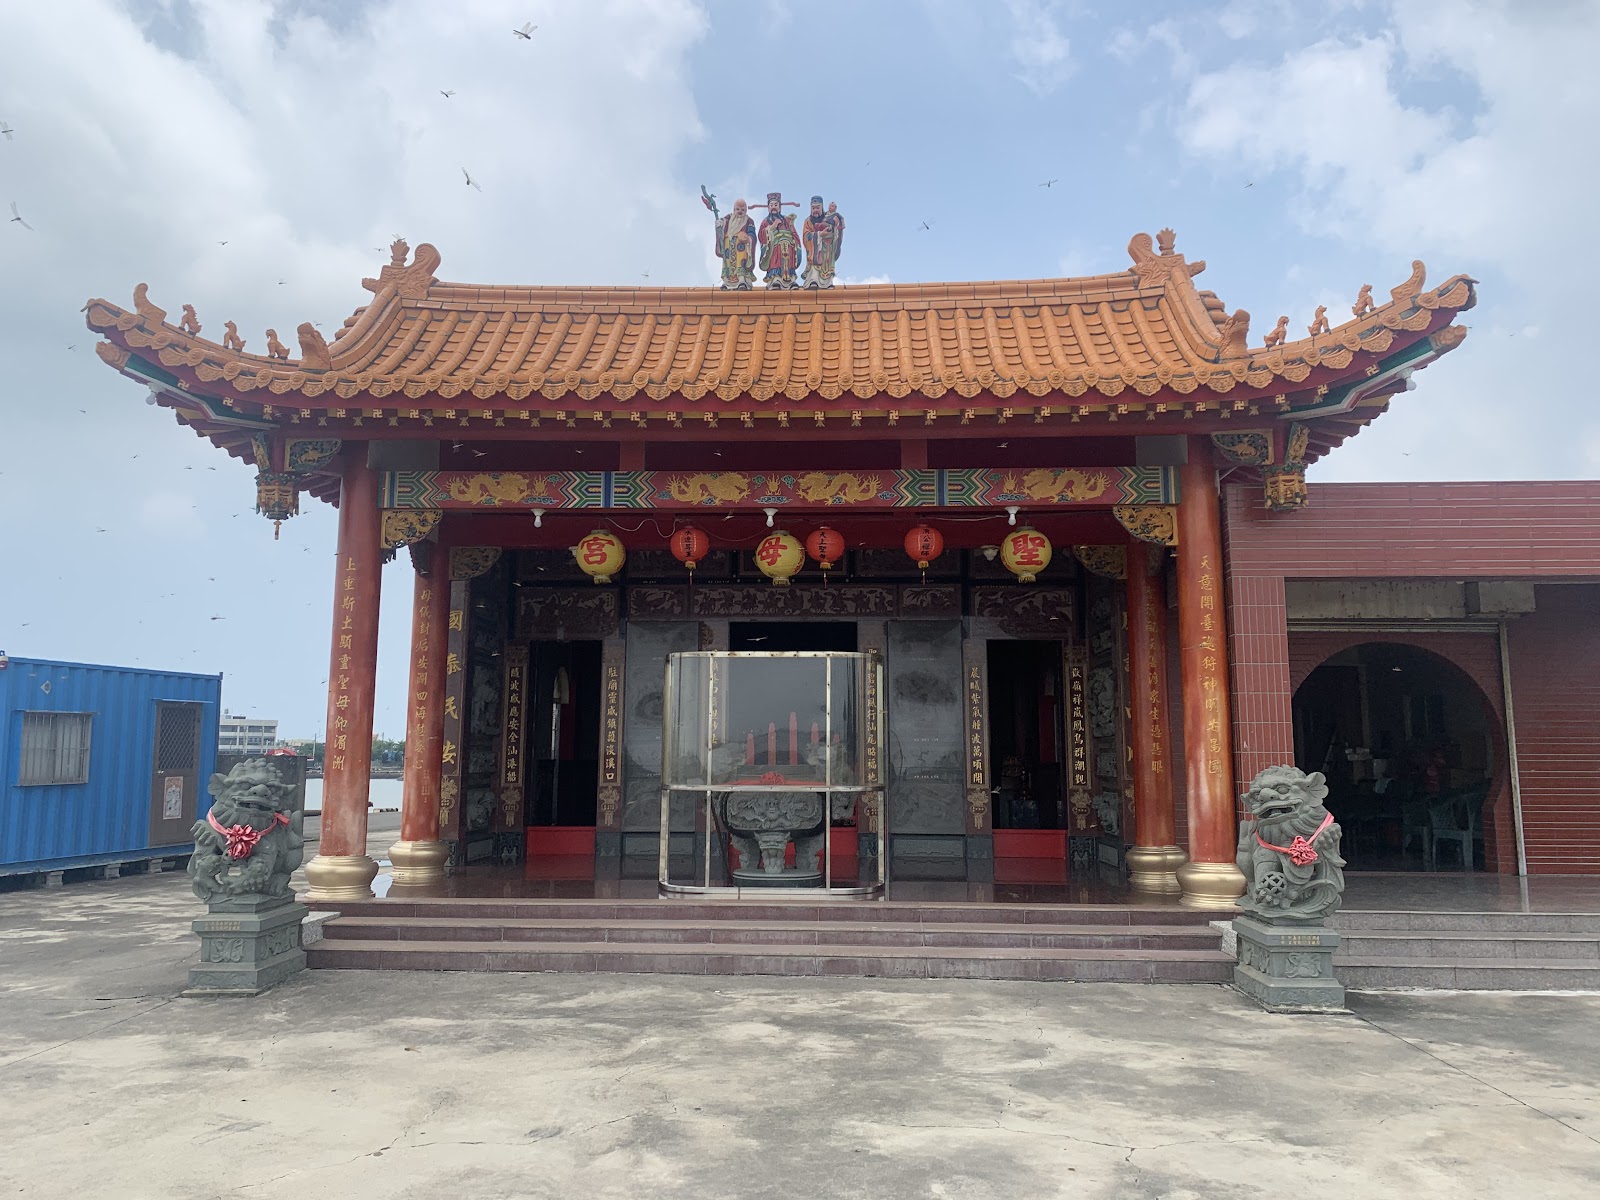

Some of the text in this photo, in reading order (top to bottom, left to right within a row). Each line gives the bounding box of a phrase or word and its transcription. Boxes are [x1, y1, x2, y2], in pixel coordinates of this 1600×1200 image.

[581, 536, 615, 566] 宮
[758, 536, 787, 566] 母
[818, 531, 827, 559] 天上聖母
[1011, 534, 1045, 566] 聖
[442, 609, 464, 765] 國泰民安
